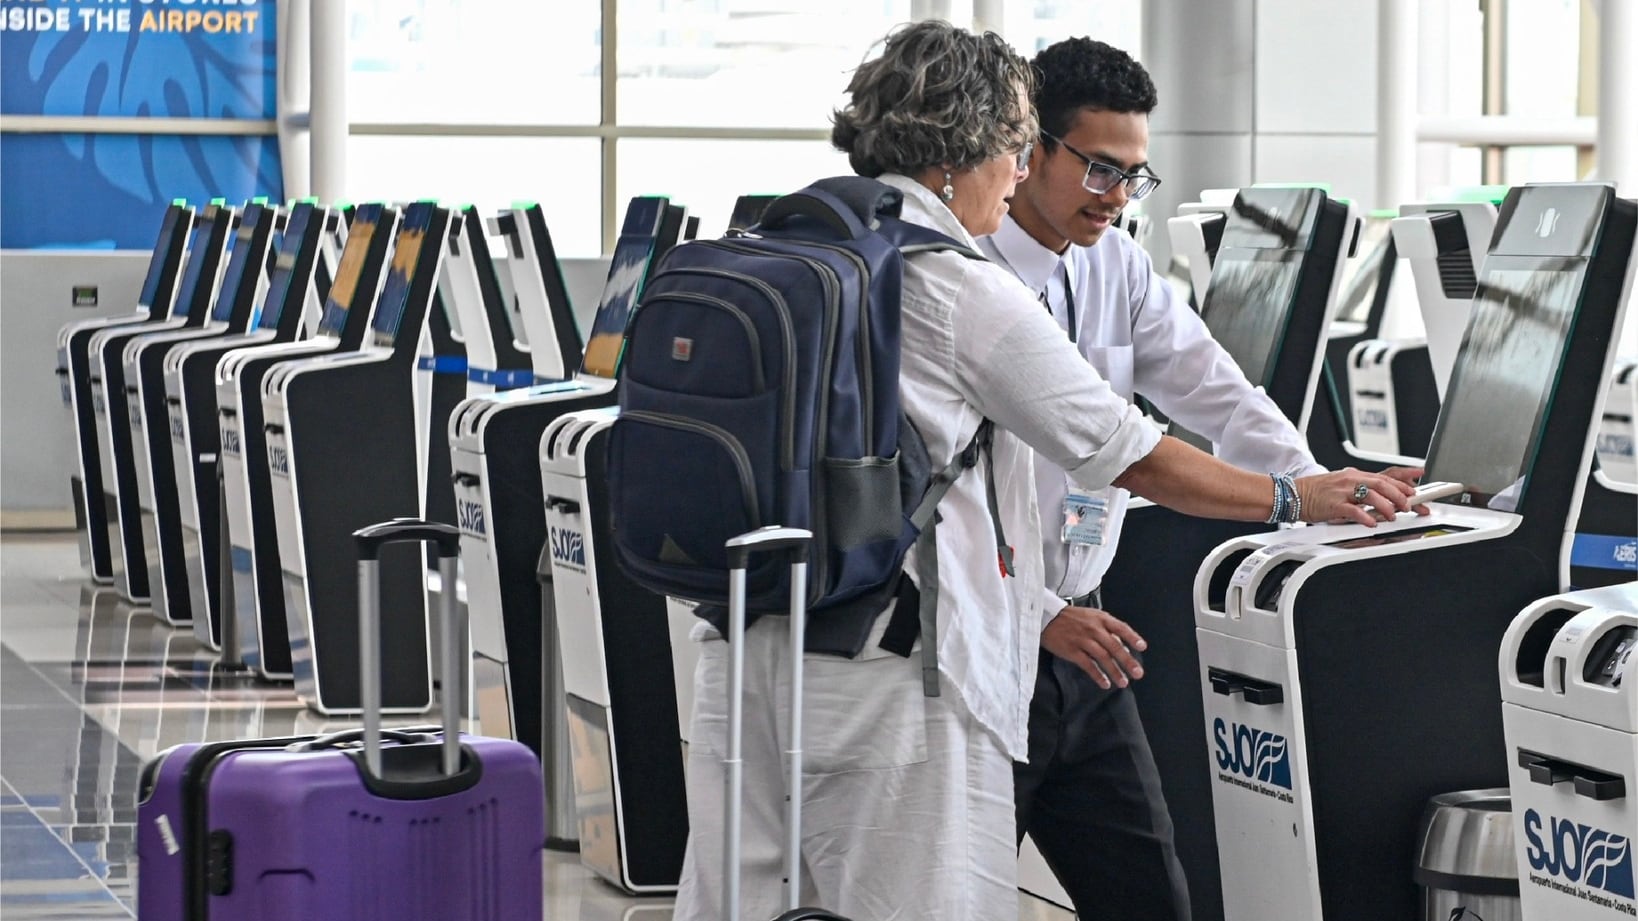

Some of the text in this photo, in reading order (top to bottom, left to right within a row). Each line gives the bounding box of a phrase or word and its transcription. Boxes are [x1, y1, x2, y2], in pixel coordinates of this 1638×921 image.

[78, 8, 131, 32] THE
[139, 9, 258, 33] AIRPORT
[1213, 717, 1254, 778] SJO
[1524, 808, 1582, 883] SJO
